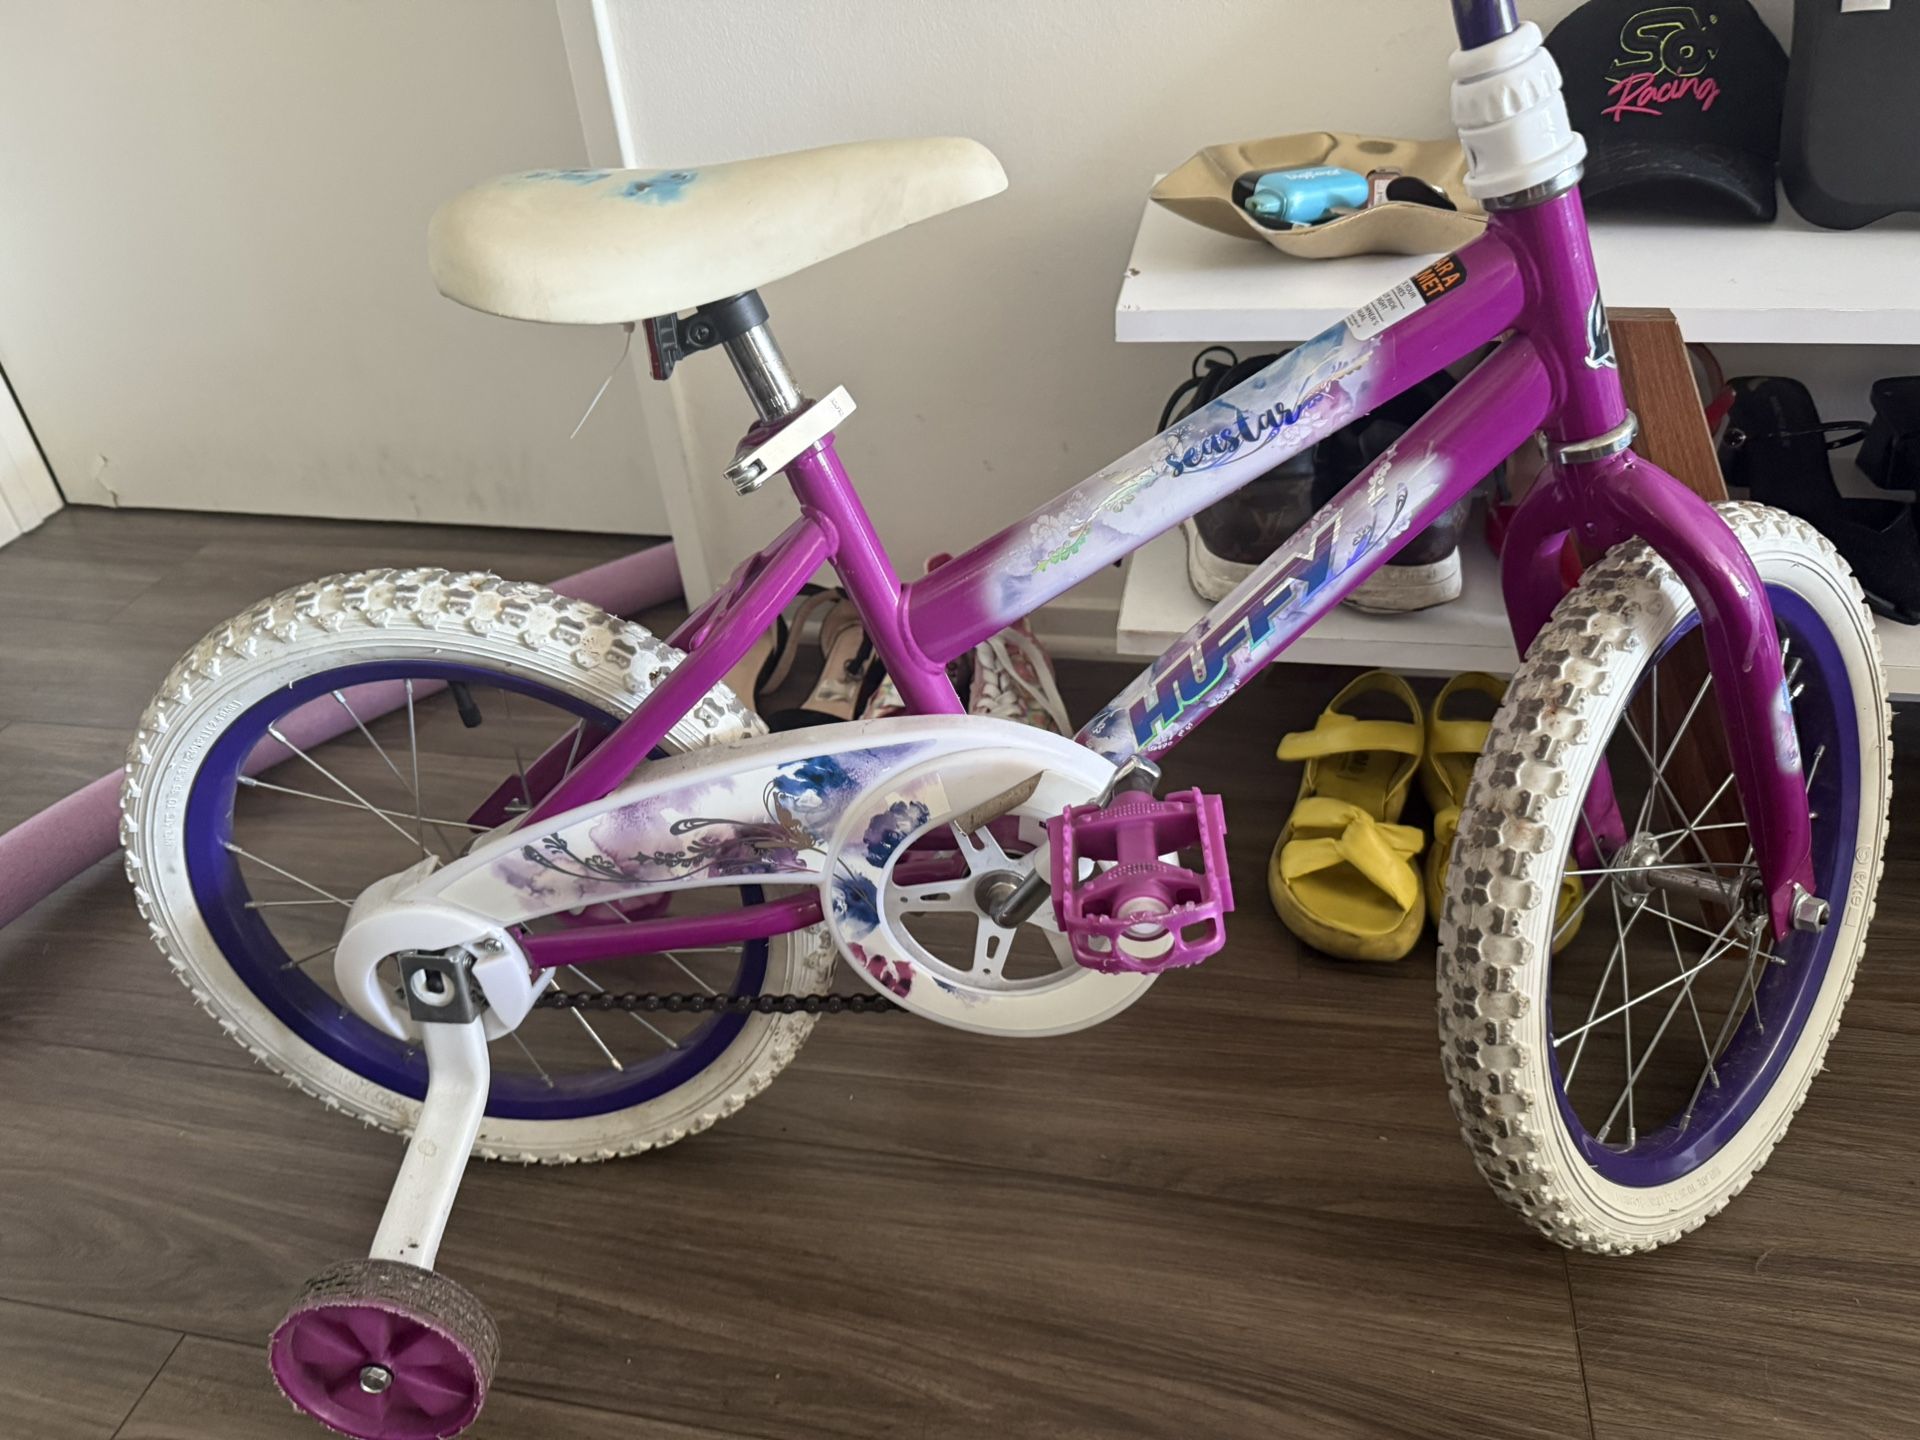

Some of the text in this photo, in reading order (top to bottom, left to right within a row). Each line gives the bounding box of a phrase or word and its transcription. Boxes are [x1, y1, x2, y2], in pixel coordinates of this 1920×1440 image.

[1600, 66, 1720, 122] Racing
[1441, 272, 1461, 288] A
[1128, 509, 1343, 753] HUFFY
